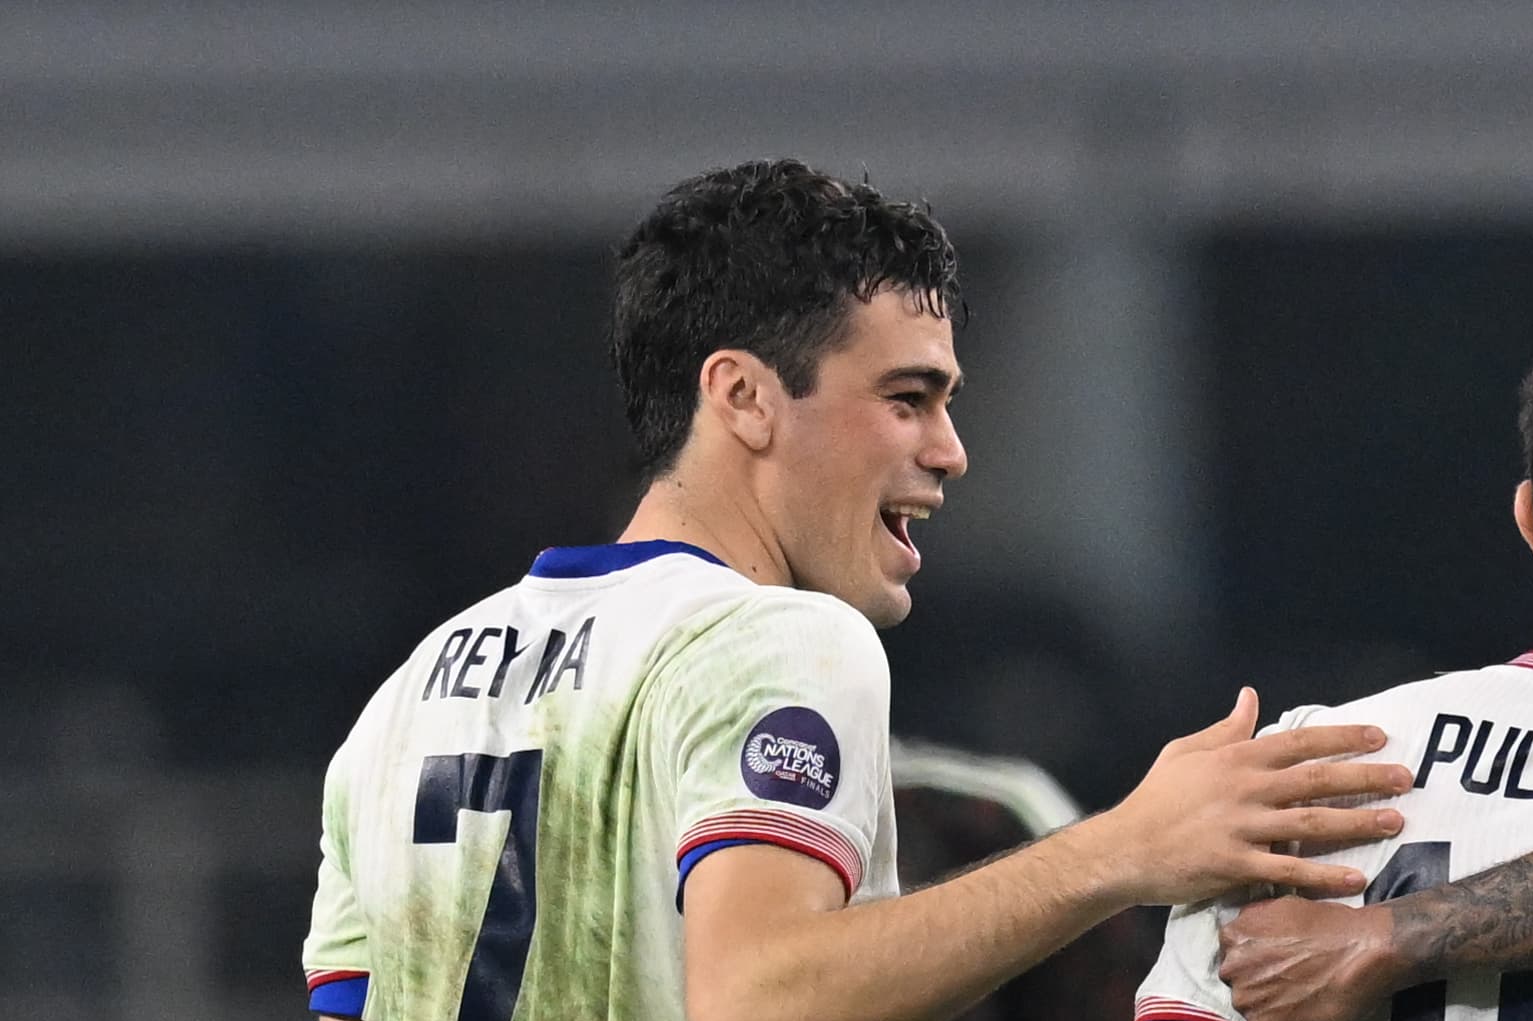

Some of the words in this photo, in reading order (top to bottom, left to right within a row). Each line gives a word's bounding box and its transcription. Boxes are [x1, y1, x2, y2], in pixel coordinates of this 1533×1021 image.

[763, 743, 825, 768] NATIONS
[782, 758, 834, 788] LEAGUE
[800, 776, 830, 799] FINALS
